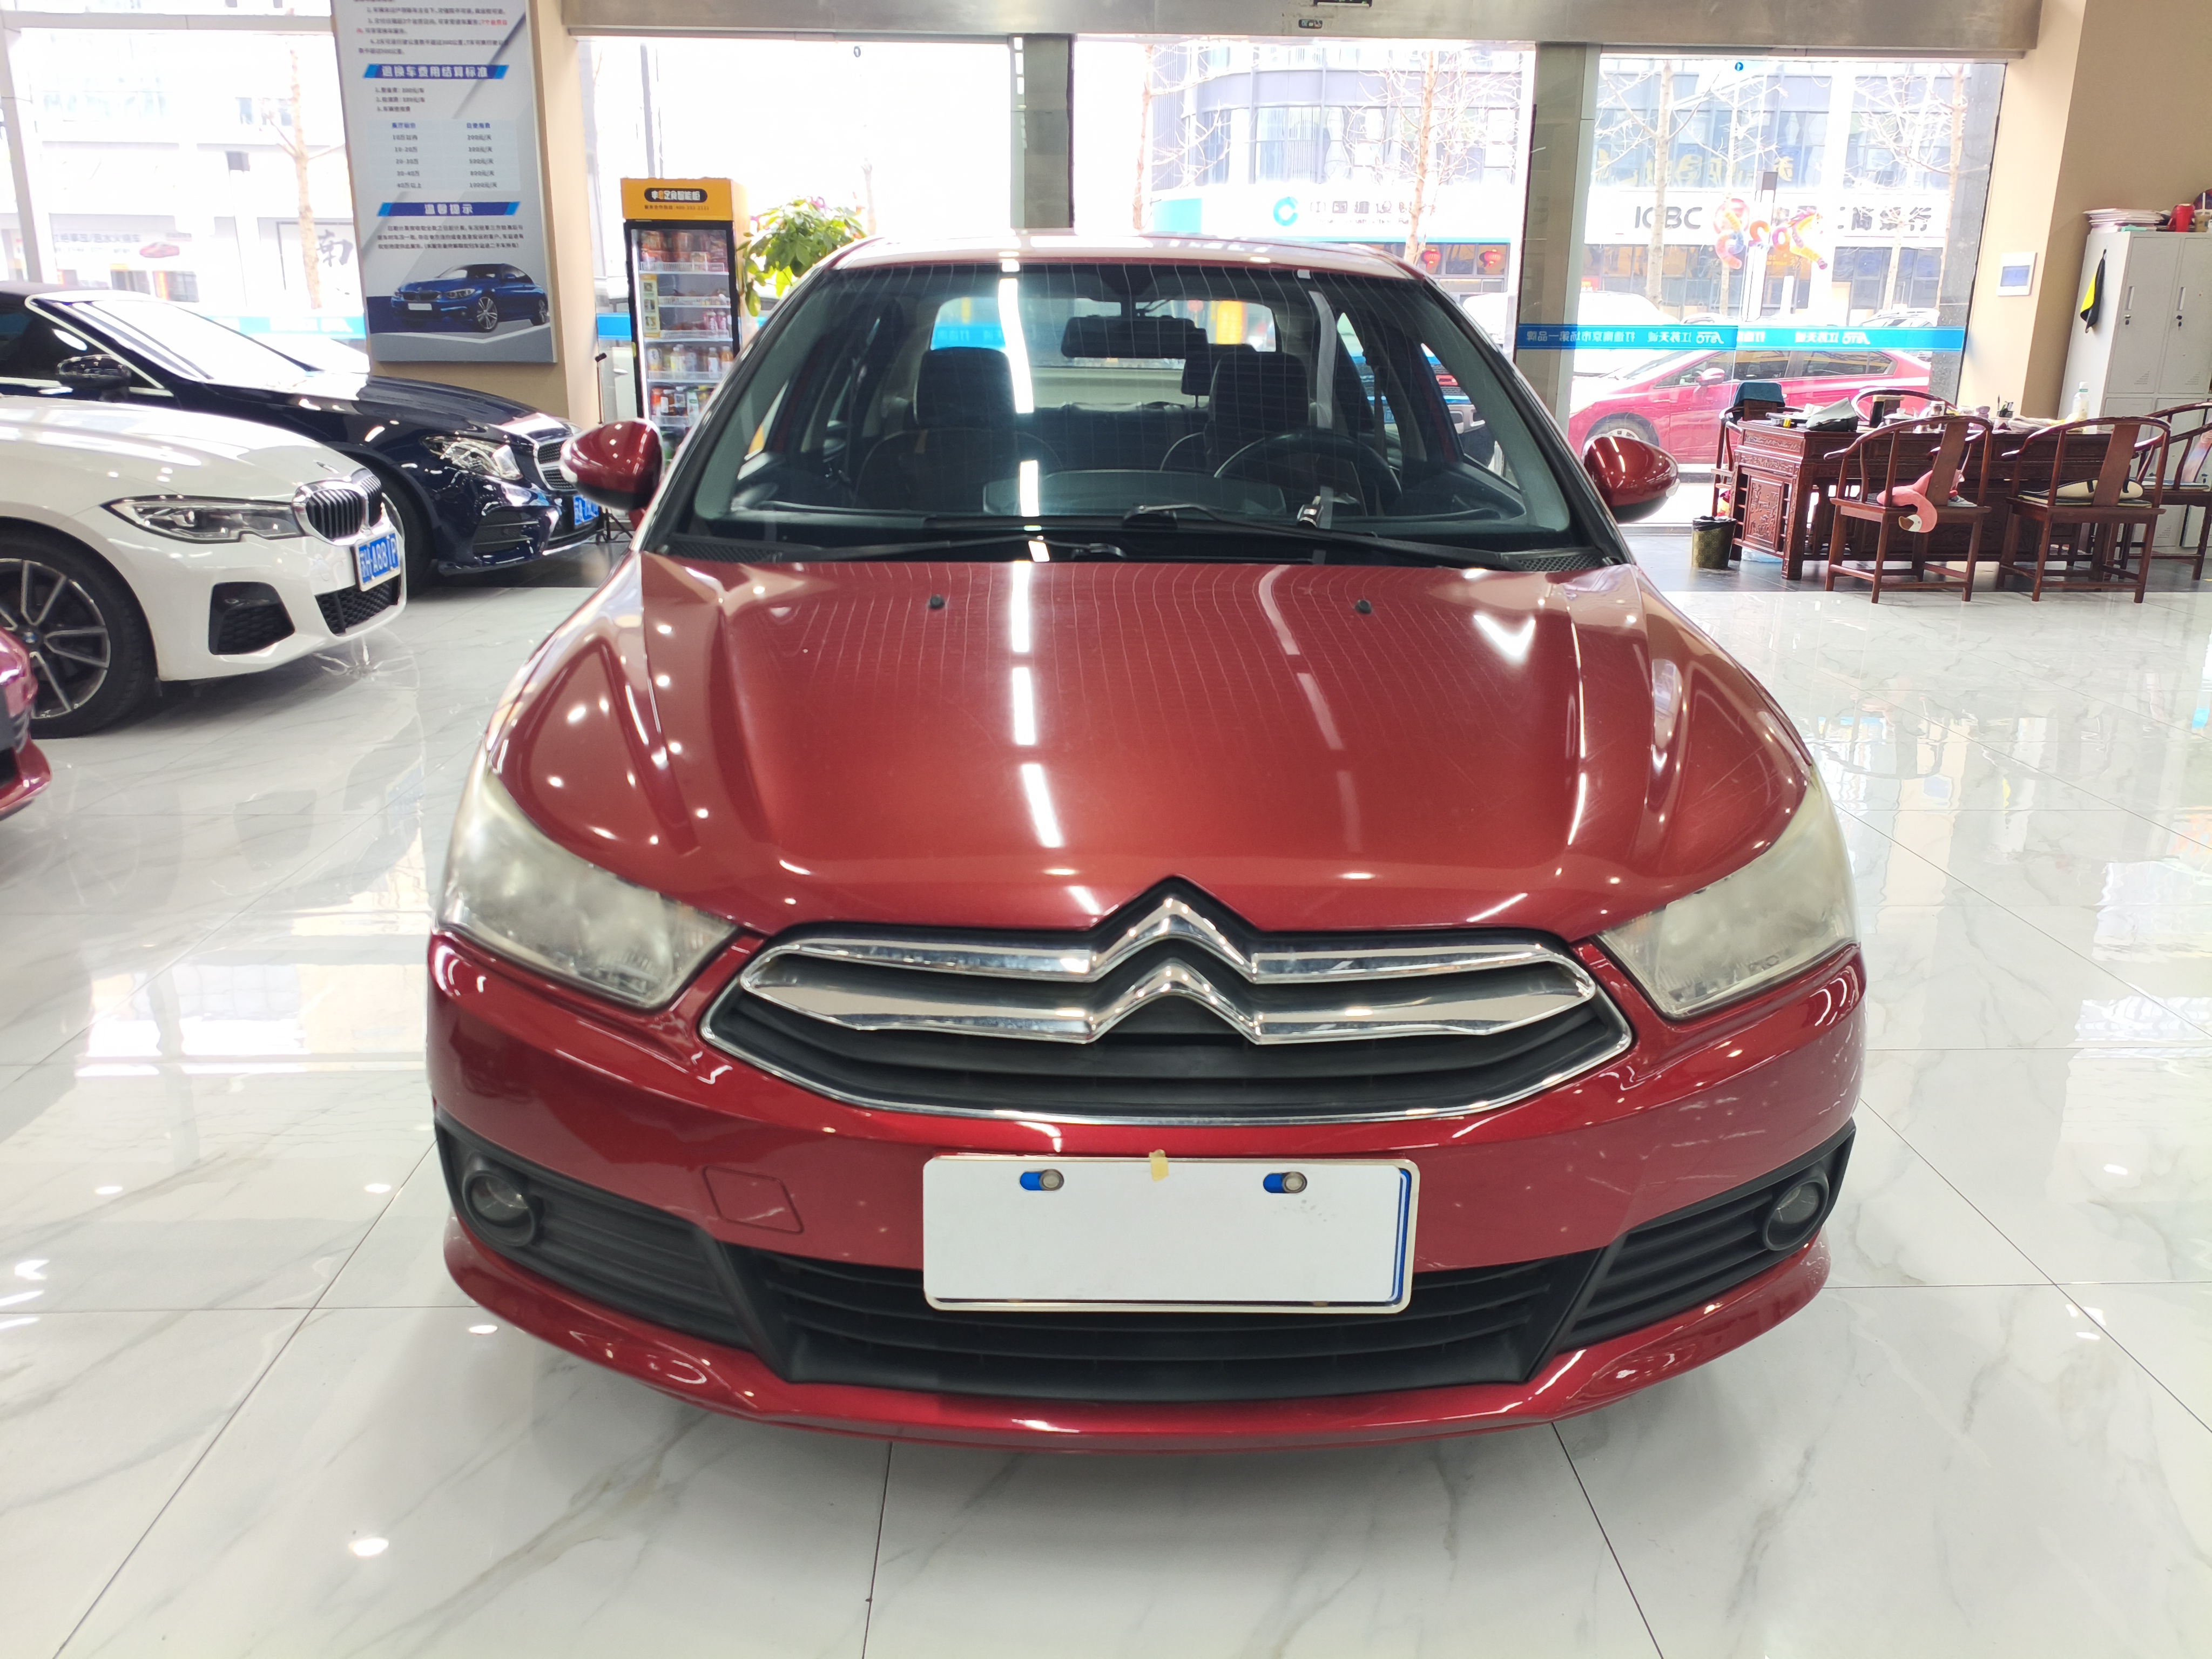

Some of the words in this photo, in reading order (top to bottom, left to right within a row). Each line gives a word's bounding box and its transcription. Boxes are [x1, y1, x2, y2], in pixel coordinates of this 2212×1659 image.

[381, 65, 488, 78] 退换车费用结算标准
